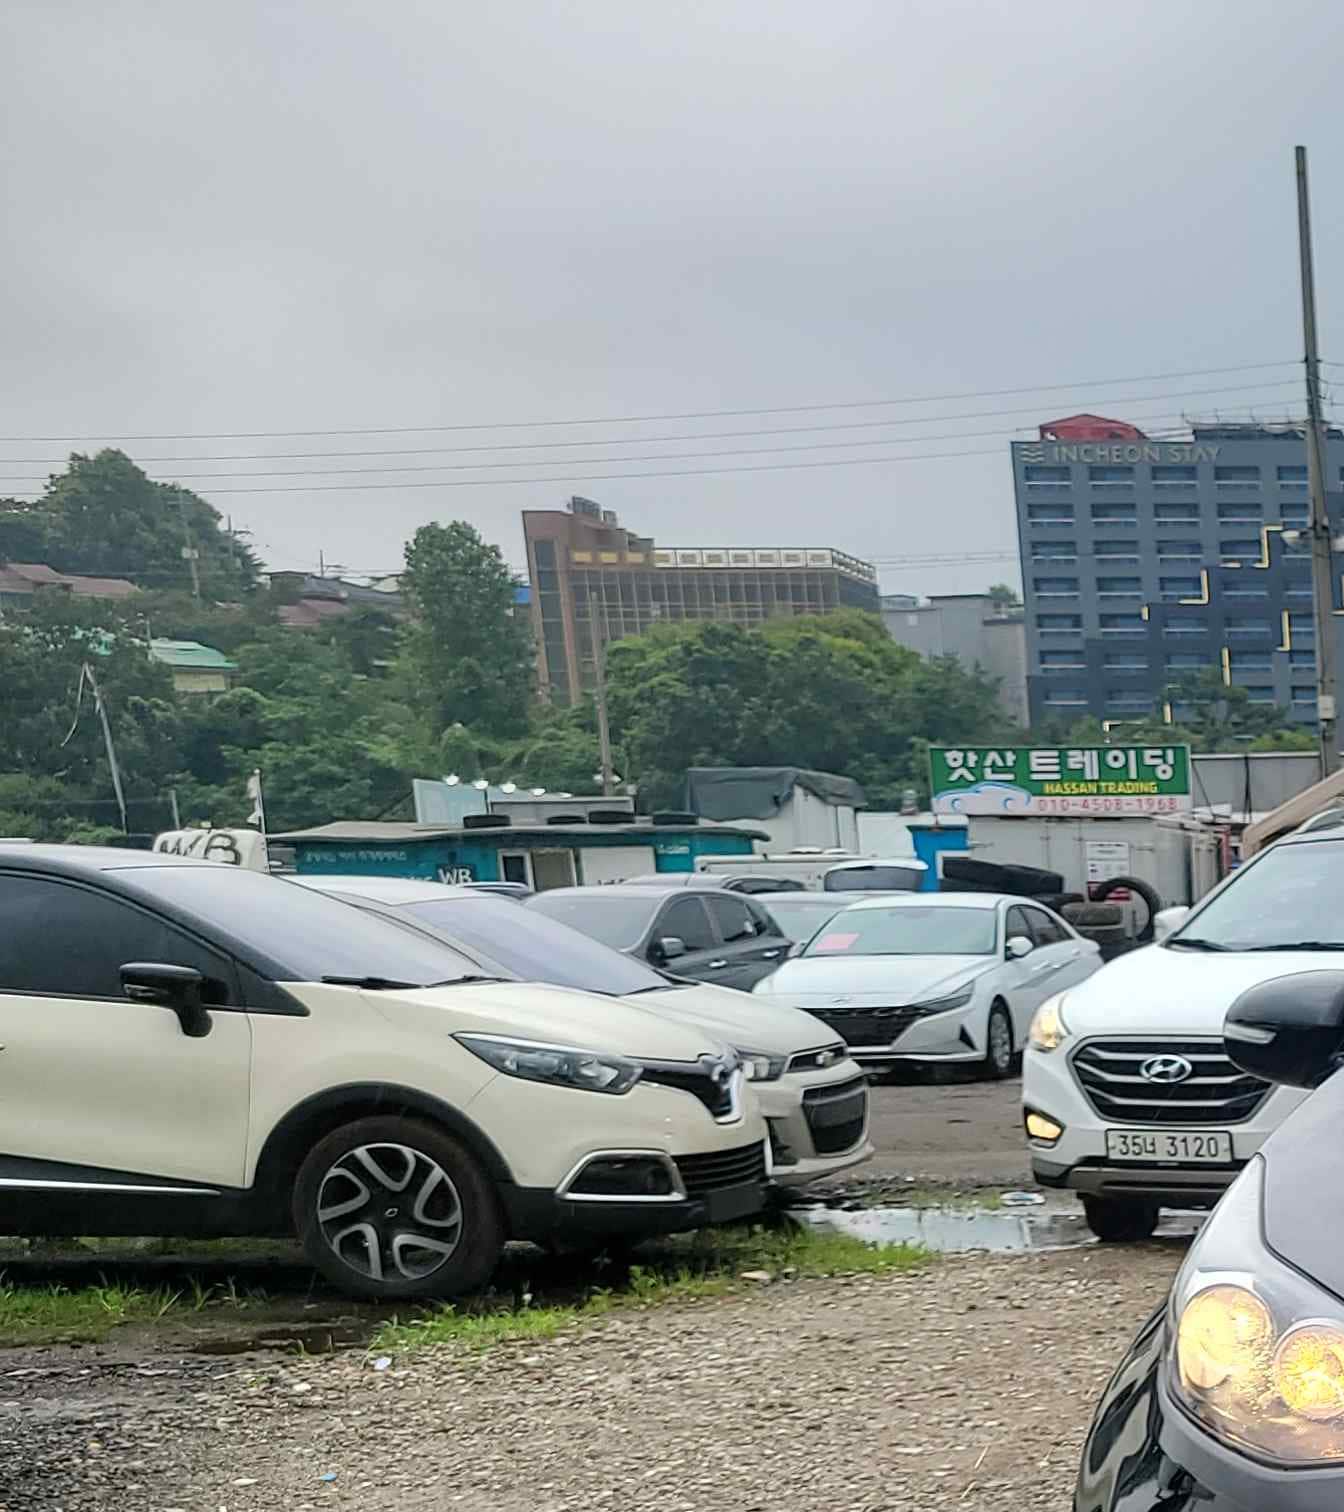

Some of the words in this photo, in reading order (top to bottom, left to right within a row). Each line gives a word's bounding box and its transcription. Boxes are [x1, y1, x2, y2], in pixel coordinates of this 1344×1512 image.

[1055, 446, 1160, 463] INCHEON
[1170, 445, 1222, 463] STAY
[944, 750, 1017, 782] 핫산
[1029, 750, 1175, 781] 트레이딩
[1044, 781, 1097, 794] HASSAN
[1102, 781, 1158, 794] TRADING
[1166, 1136, 1219, 1157] 3120
